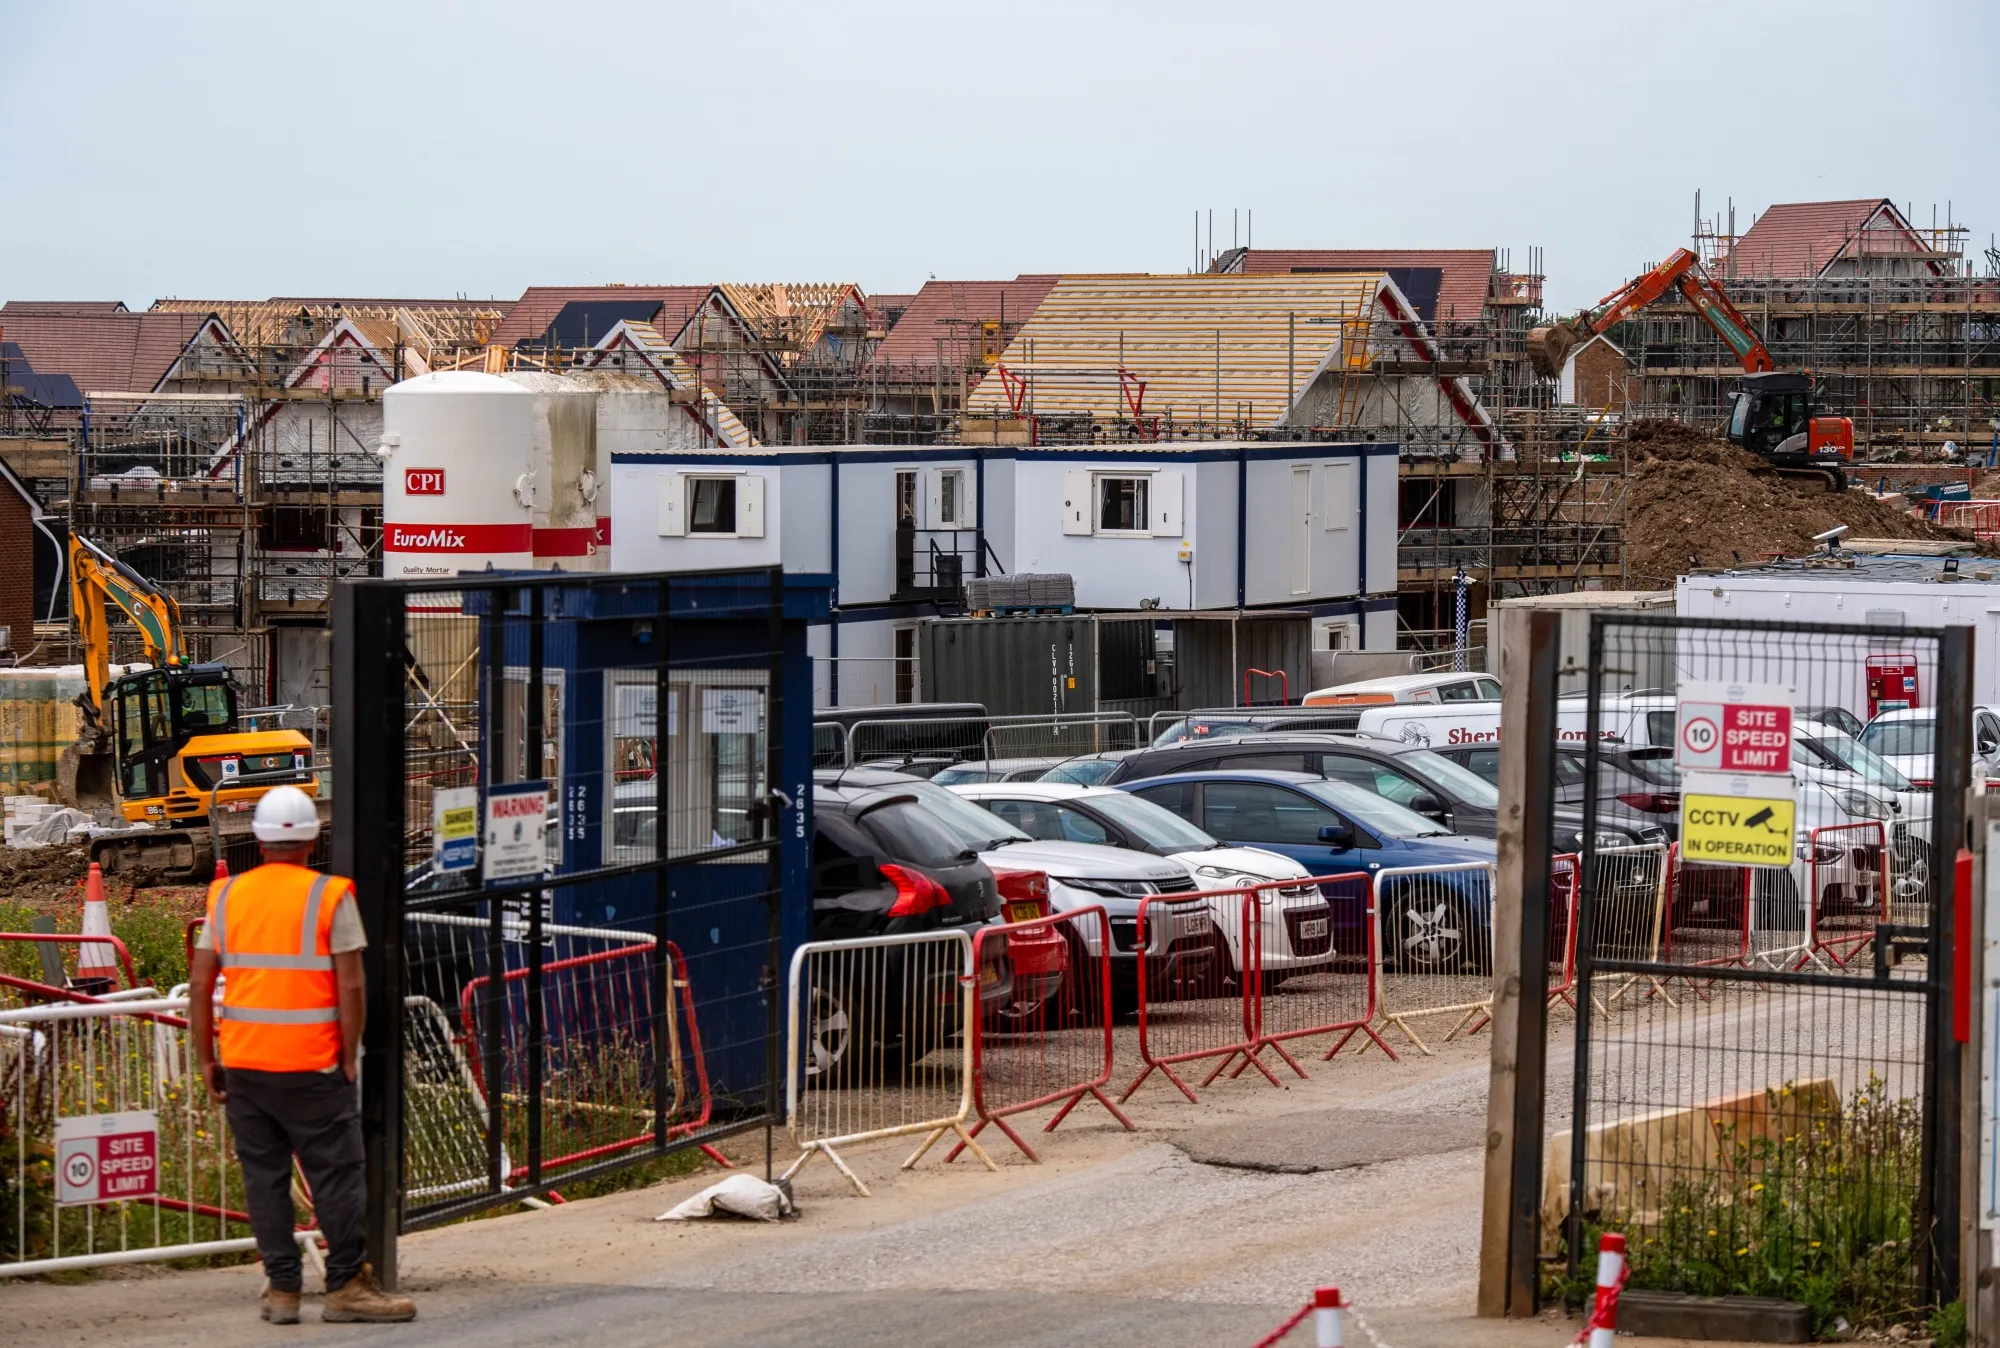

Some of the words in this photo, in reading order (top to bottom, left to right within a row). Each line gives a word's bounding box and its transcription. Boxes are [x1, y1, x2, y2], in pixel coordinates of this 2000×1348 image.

[406, 473, 442, 491] CPI
[393, 528, 466, 548] EuroMix
[403, 566, 424, 574] Quality
[1736, 710, 1777, 727] SITE
[1692, 728, 1711, 743] 10
[1726, 729, 1787, 747] SPEED
[1732, 749, 1780, 766] LIMIT
[493, 796, 544, 818] WARNING
[796, 784, 805, 838] 2635
[1689, 809, 1740, 827] CCTV
[1688, 839, 1701, 852] IN
[1705, 840, 1787, 857] OPERATION
[109, 1138, 145, 1154] SITE
[71, 1162, 89, 1177] 10
[101, 1156, 153, 1174] SPEED
[107, 1175, 148, 1193] LIMIT
